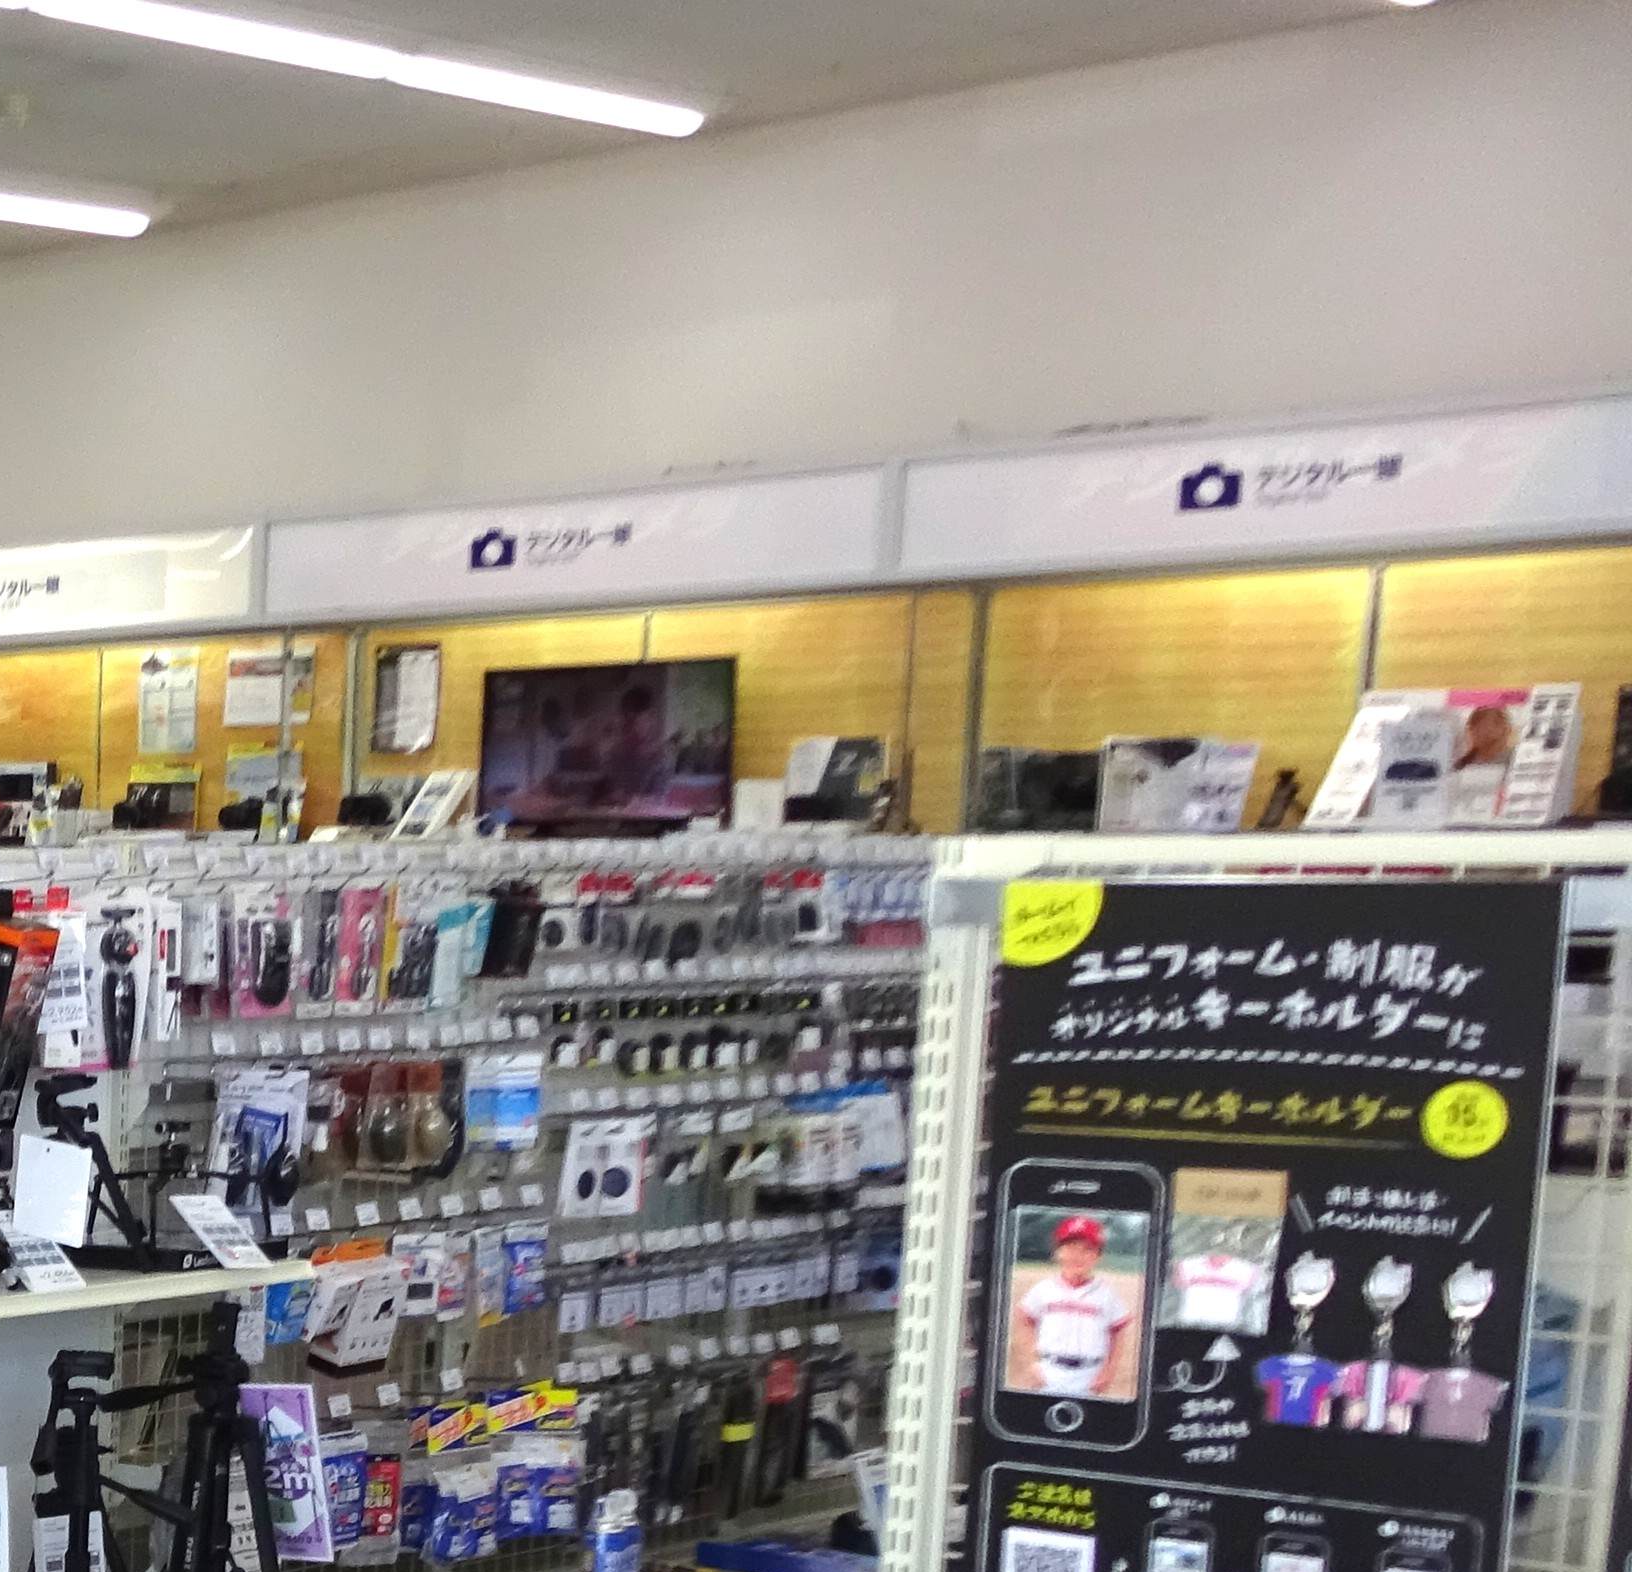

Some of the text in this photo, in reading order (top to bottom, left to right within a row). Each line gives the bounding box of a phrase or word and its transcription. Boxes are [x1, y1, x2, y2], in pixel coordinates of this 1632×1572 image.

[1067, 936, 1485, 1000] ユニフォーム・制服が
[1048, 986, 1489, 1052] オリジナルキーホルダーに
[1021, 1083, 1415, 1131] ユニフォームキーホルダー
